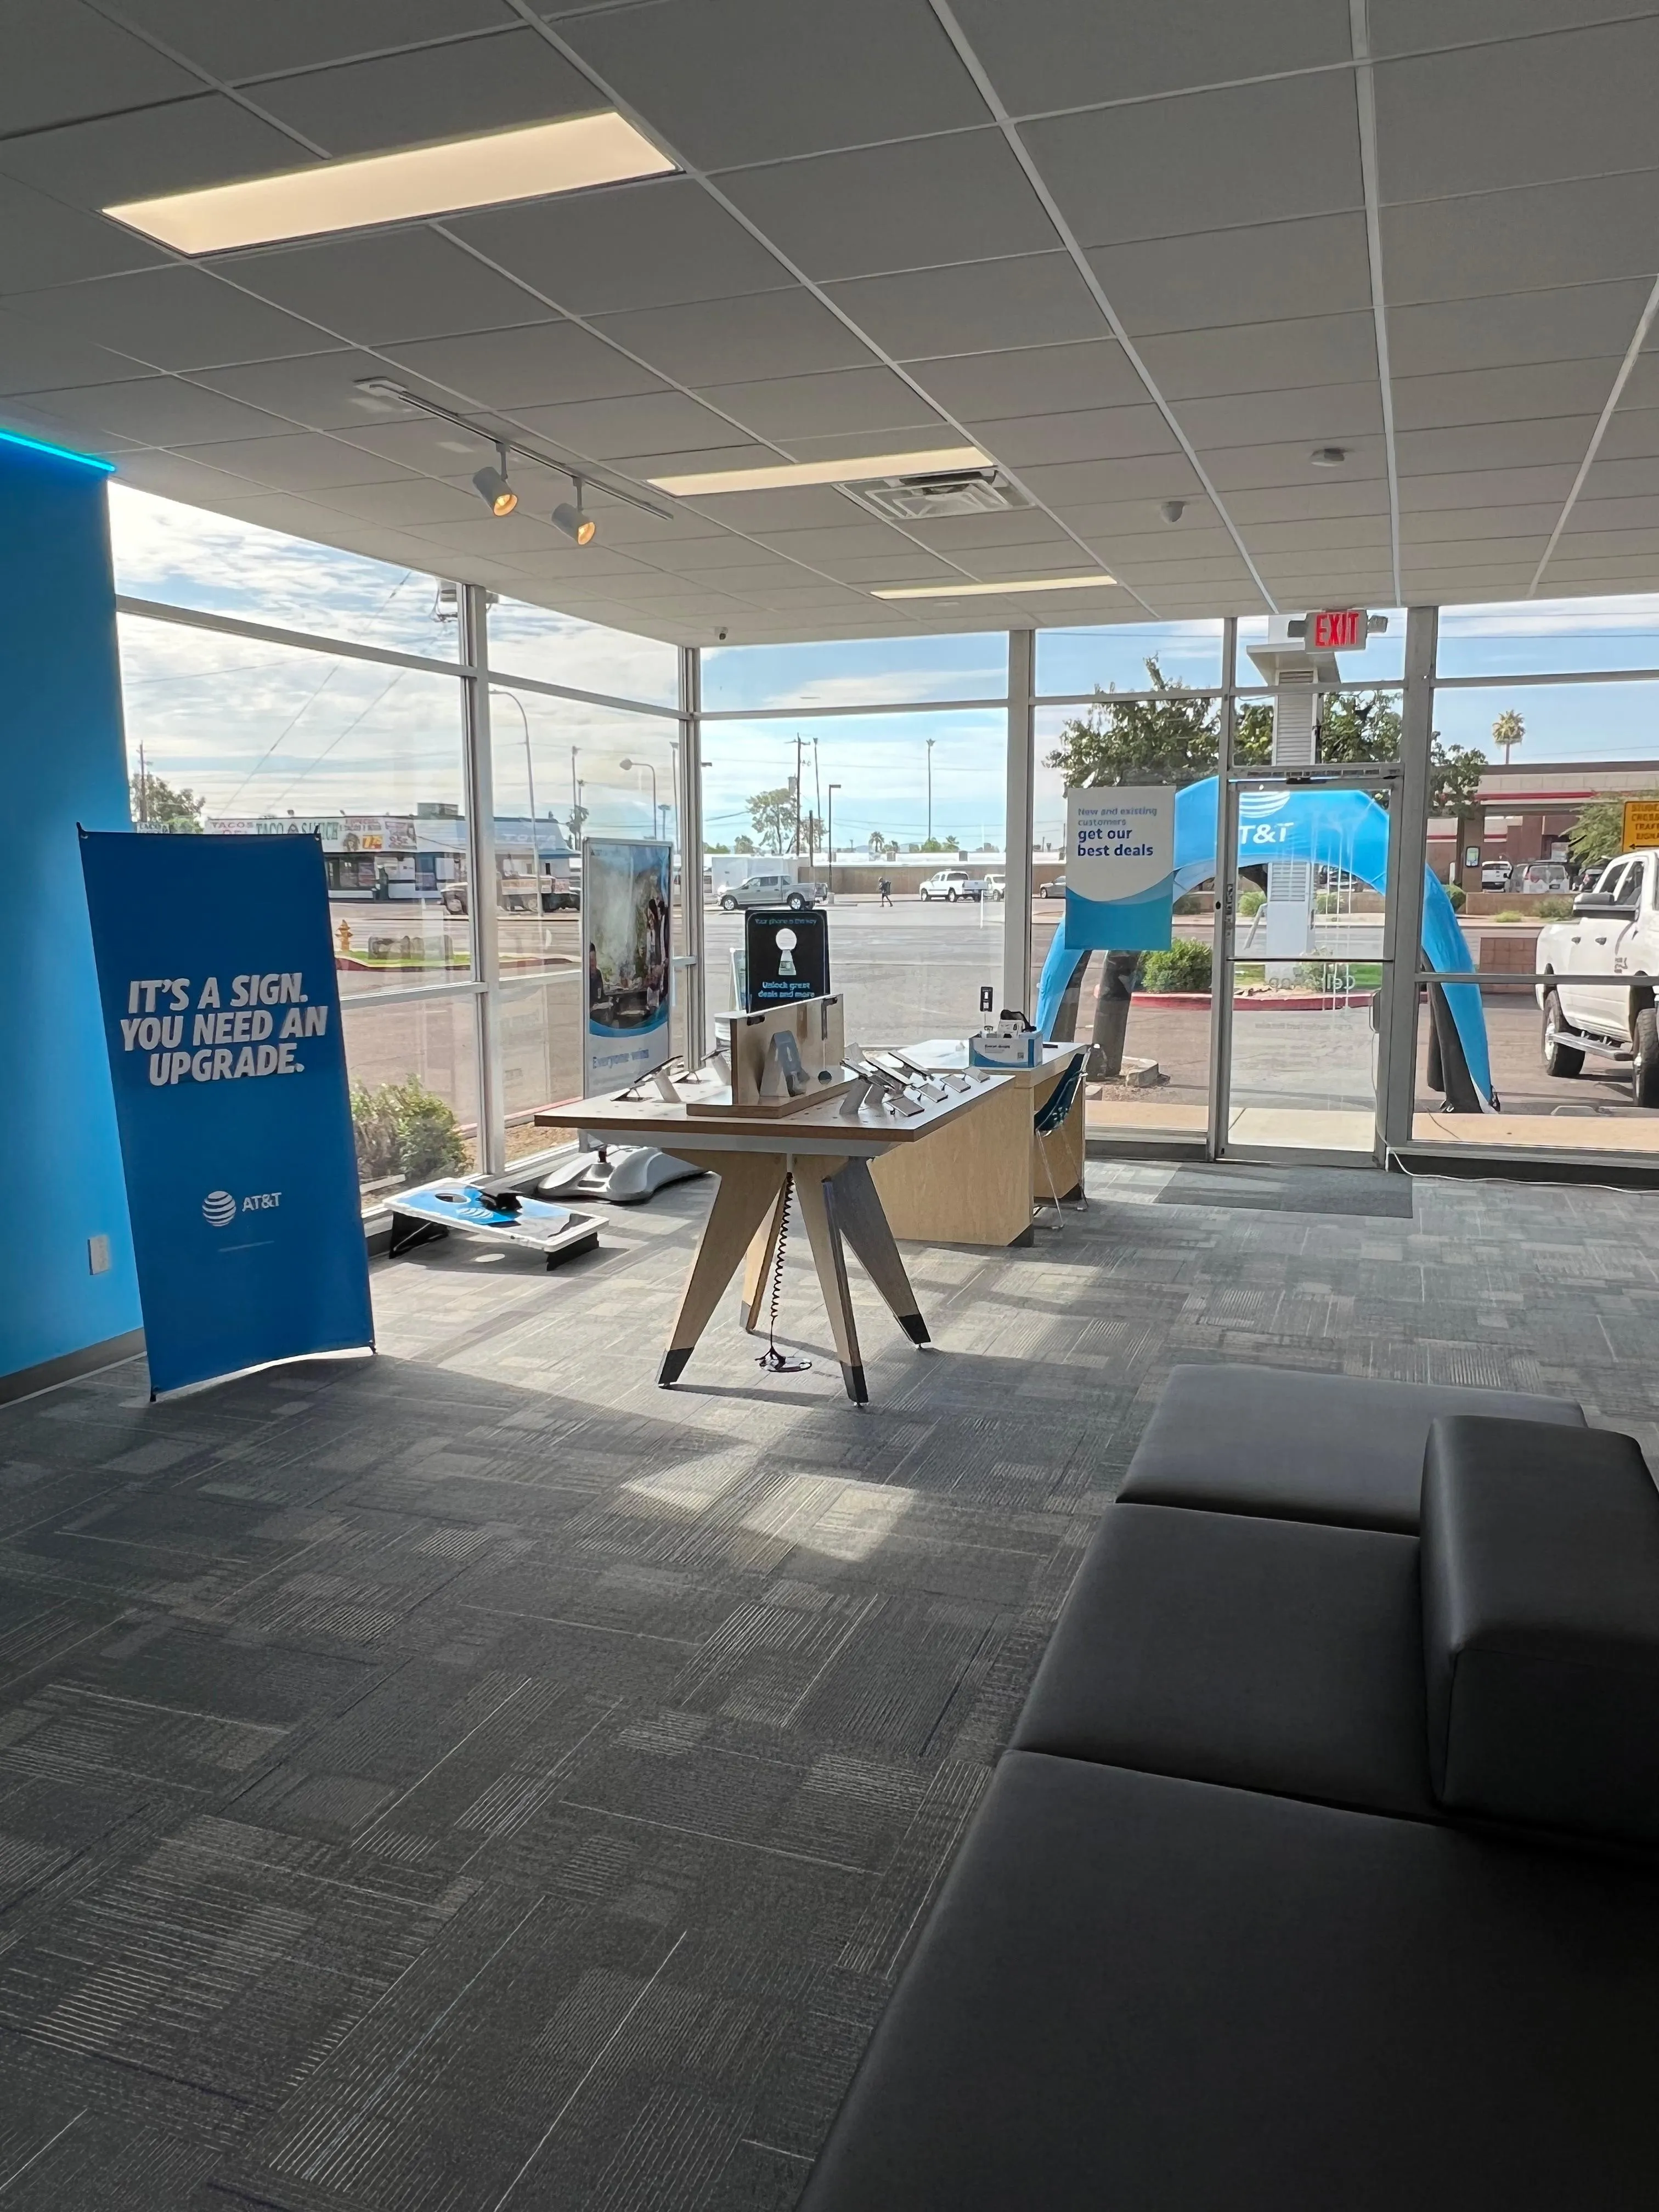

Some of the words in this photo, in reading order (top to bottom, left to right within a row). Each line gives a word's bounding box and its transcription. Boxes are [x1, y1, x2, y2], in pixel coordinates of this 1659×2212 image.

[1315, 612, 1360, 647] EXIT
[1078, 808, 1098, 816] New
[1101, 808, 1118, 816] and
[1120, 806, 1158, 817] existing
[1078, 828, 1103, 843] get
[1107, 829, 1133, 839] our
[1239, 822, 1294, 845] T&T
[1077, 844, 1110, 856] best
[1114, 843, 1153, 856] deals
[128, 978, 190, 1014] IT'S
[197, 977, 220, 1009] A
[230, 972, 308, 1007] SIGN.
[789, 982, 810, 991] great
[120, 1015, 184, 1051] YOU
[193, 1009, 273, 1046] NEED
[279, 1006, 328, 1039] AN
[149, 1042, 305, 1086] UPGRADE.
[592, 1053, 629, 1069] Everyone
[241, 1192, 282, 1212] AT&T
